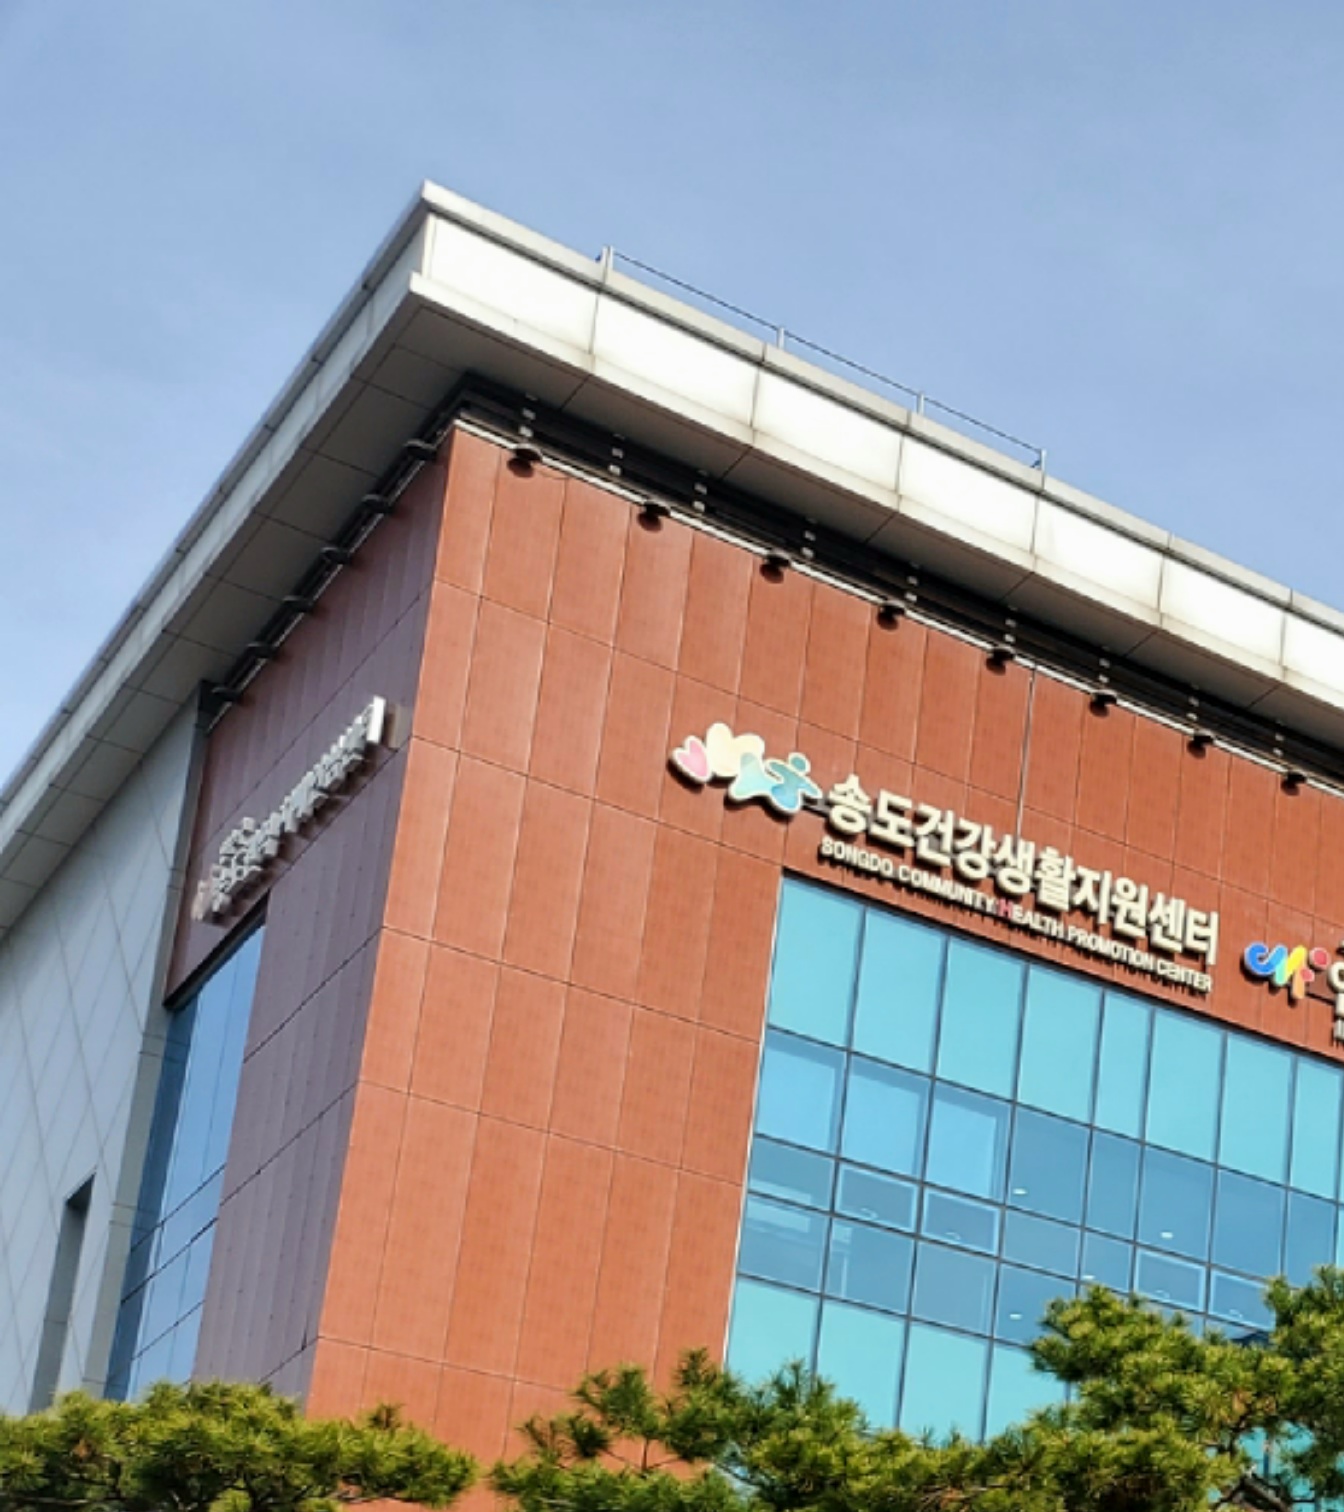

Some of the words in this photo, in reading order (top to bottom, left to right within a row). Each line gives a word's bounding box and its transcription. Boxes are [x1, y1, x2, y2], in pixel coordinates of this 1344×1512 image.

[821, 836, 893, 876] SONGDO
[899, 865, 997, 913] COMMUNITY
[998, 899, 1064, 937] HEALTH
[1068, 926, 1153, 970] PROMOTION
[1157, 959, 1212, 992] CENTER
[828, 774, 1218, 965] 송도건강생활지원센터
